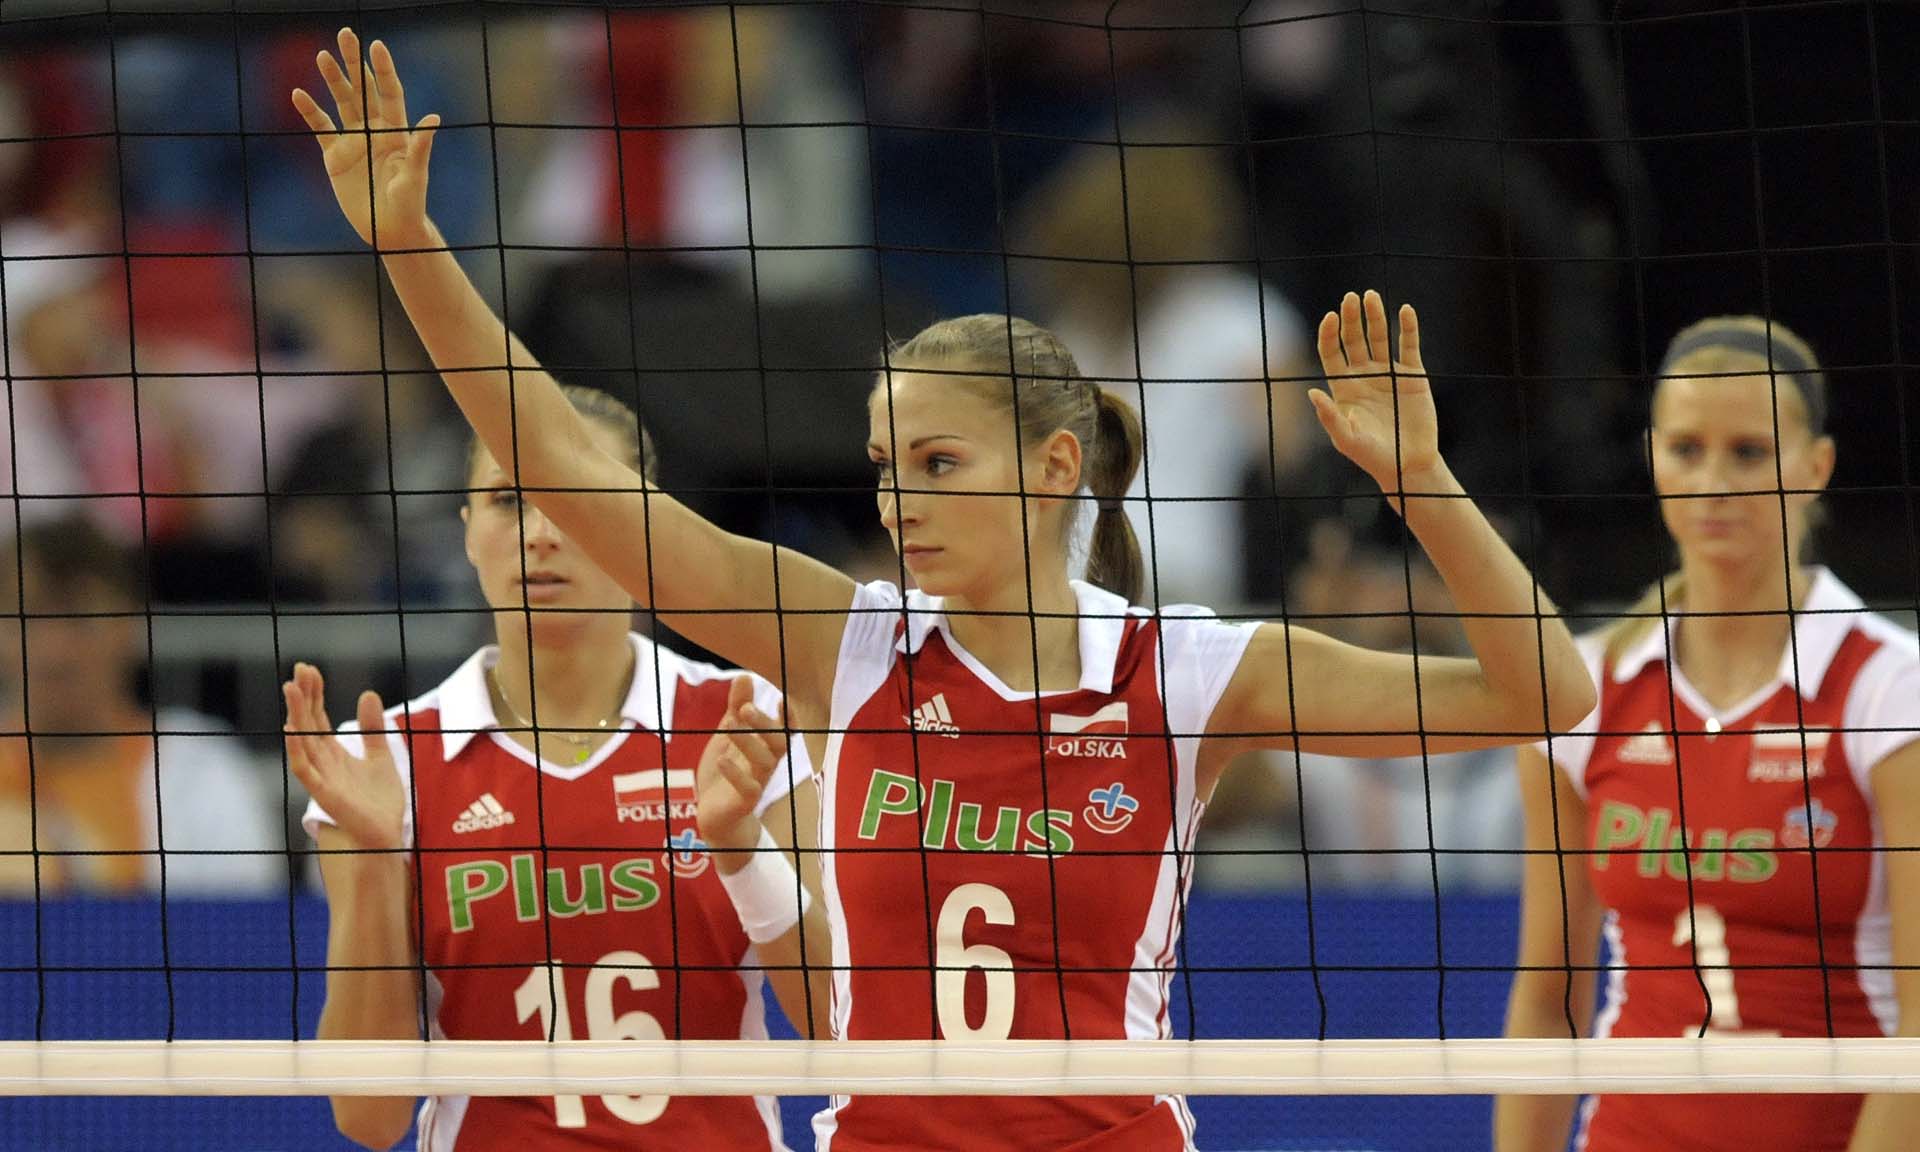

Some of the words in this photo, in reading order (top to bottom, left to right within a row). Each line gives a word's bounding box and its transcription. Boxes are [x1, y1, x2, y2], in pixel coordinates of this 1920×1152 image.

[1045, 740, 1127, 759] OLSKA
[617, 802, 699, 823] POLSKA
[857, 768, 1075, 858] Plus
[1592, 799, 1778, 882] Plus
[445, 853, 660, 933] Plus
[936, 883, 1016, 1040] 6
[1672, 903, 1743, 1029] 1
[514, 950, 675, 1128] 16
